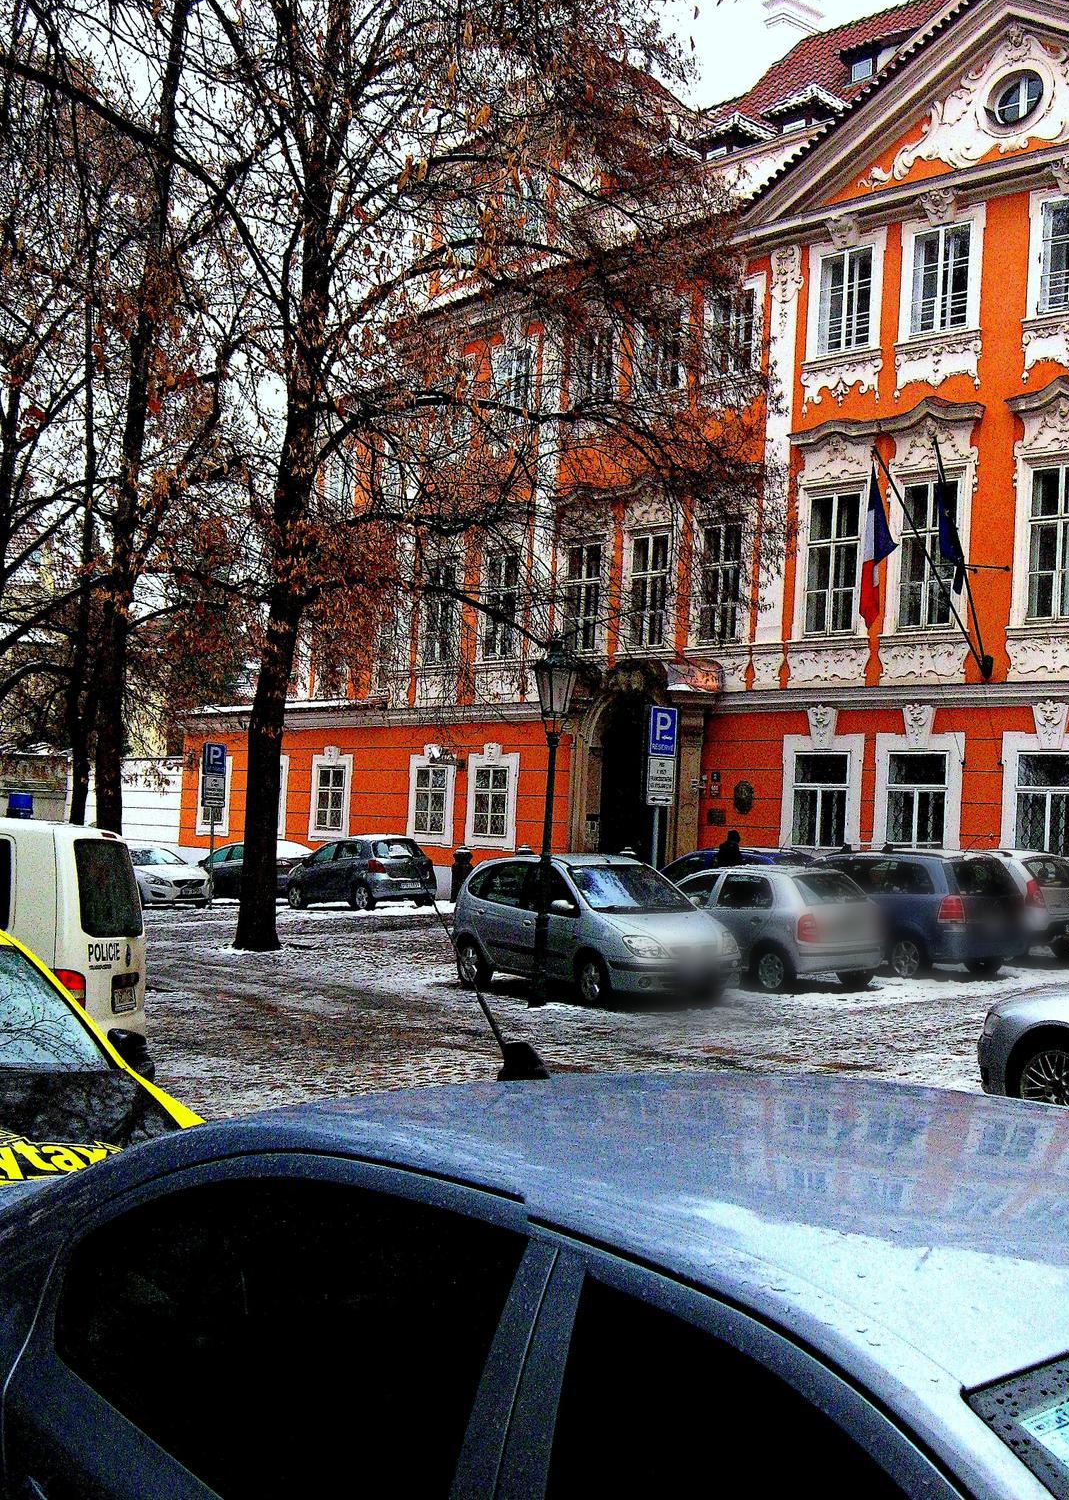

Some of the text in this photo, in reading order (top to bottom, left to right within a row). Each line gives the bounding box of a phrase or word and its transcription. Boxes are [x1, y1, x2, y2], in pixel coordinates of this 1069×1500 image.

[655, 712, 672, 741] P
[210, 745, 222, 765] P
[87, 942, 121, 962] POLICIE
